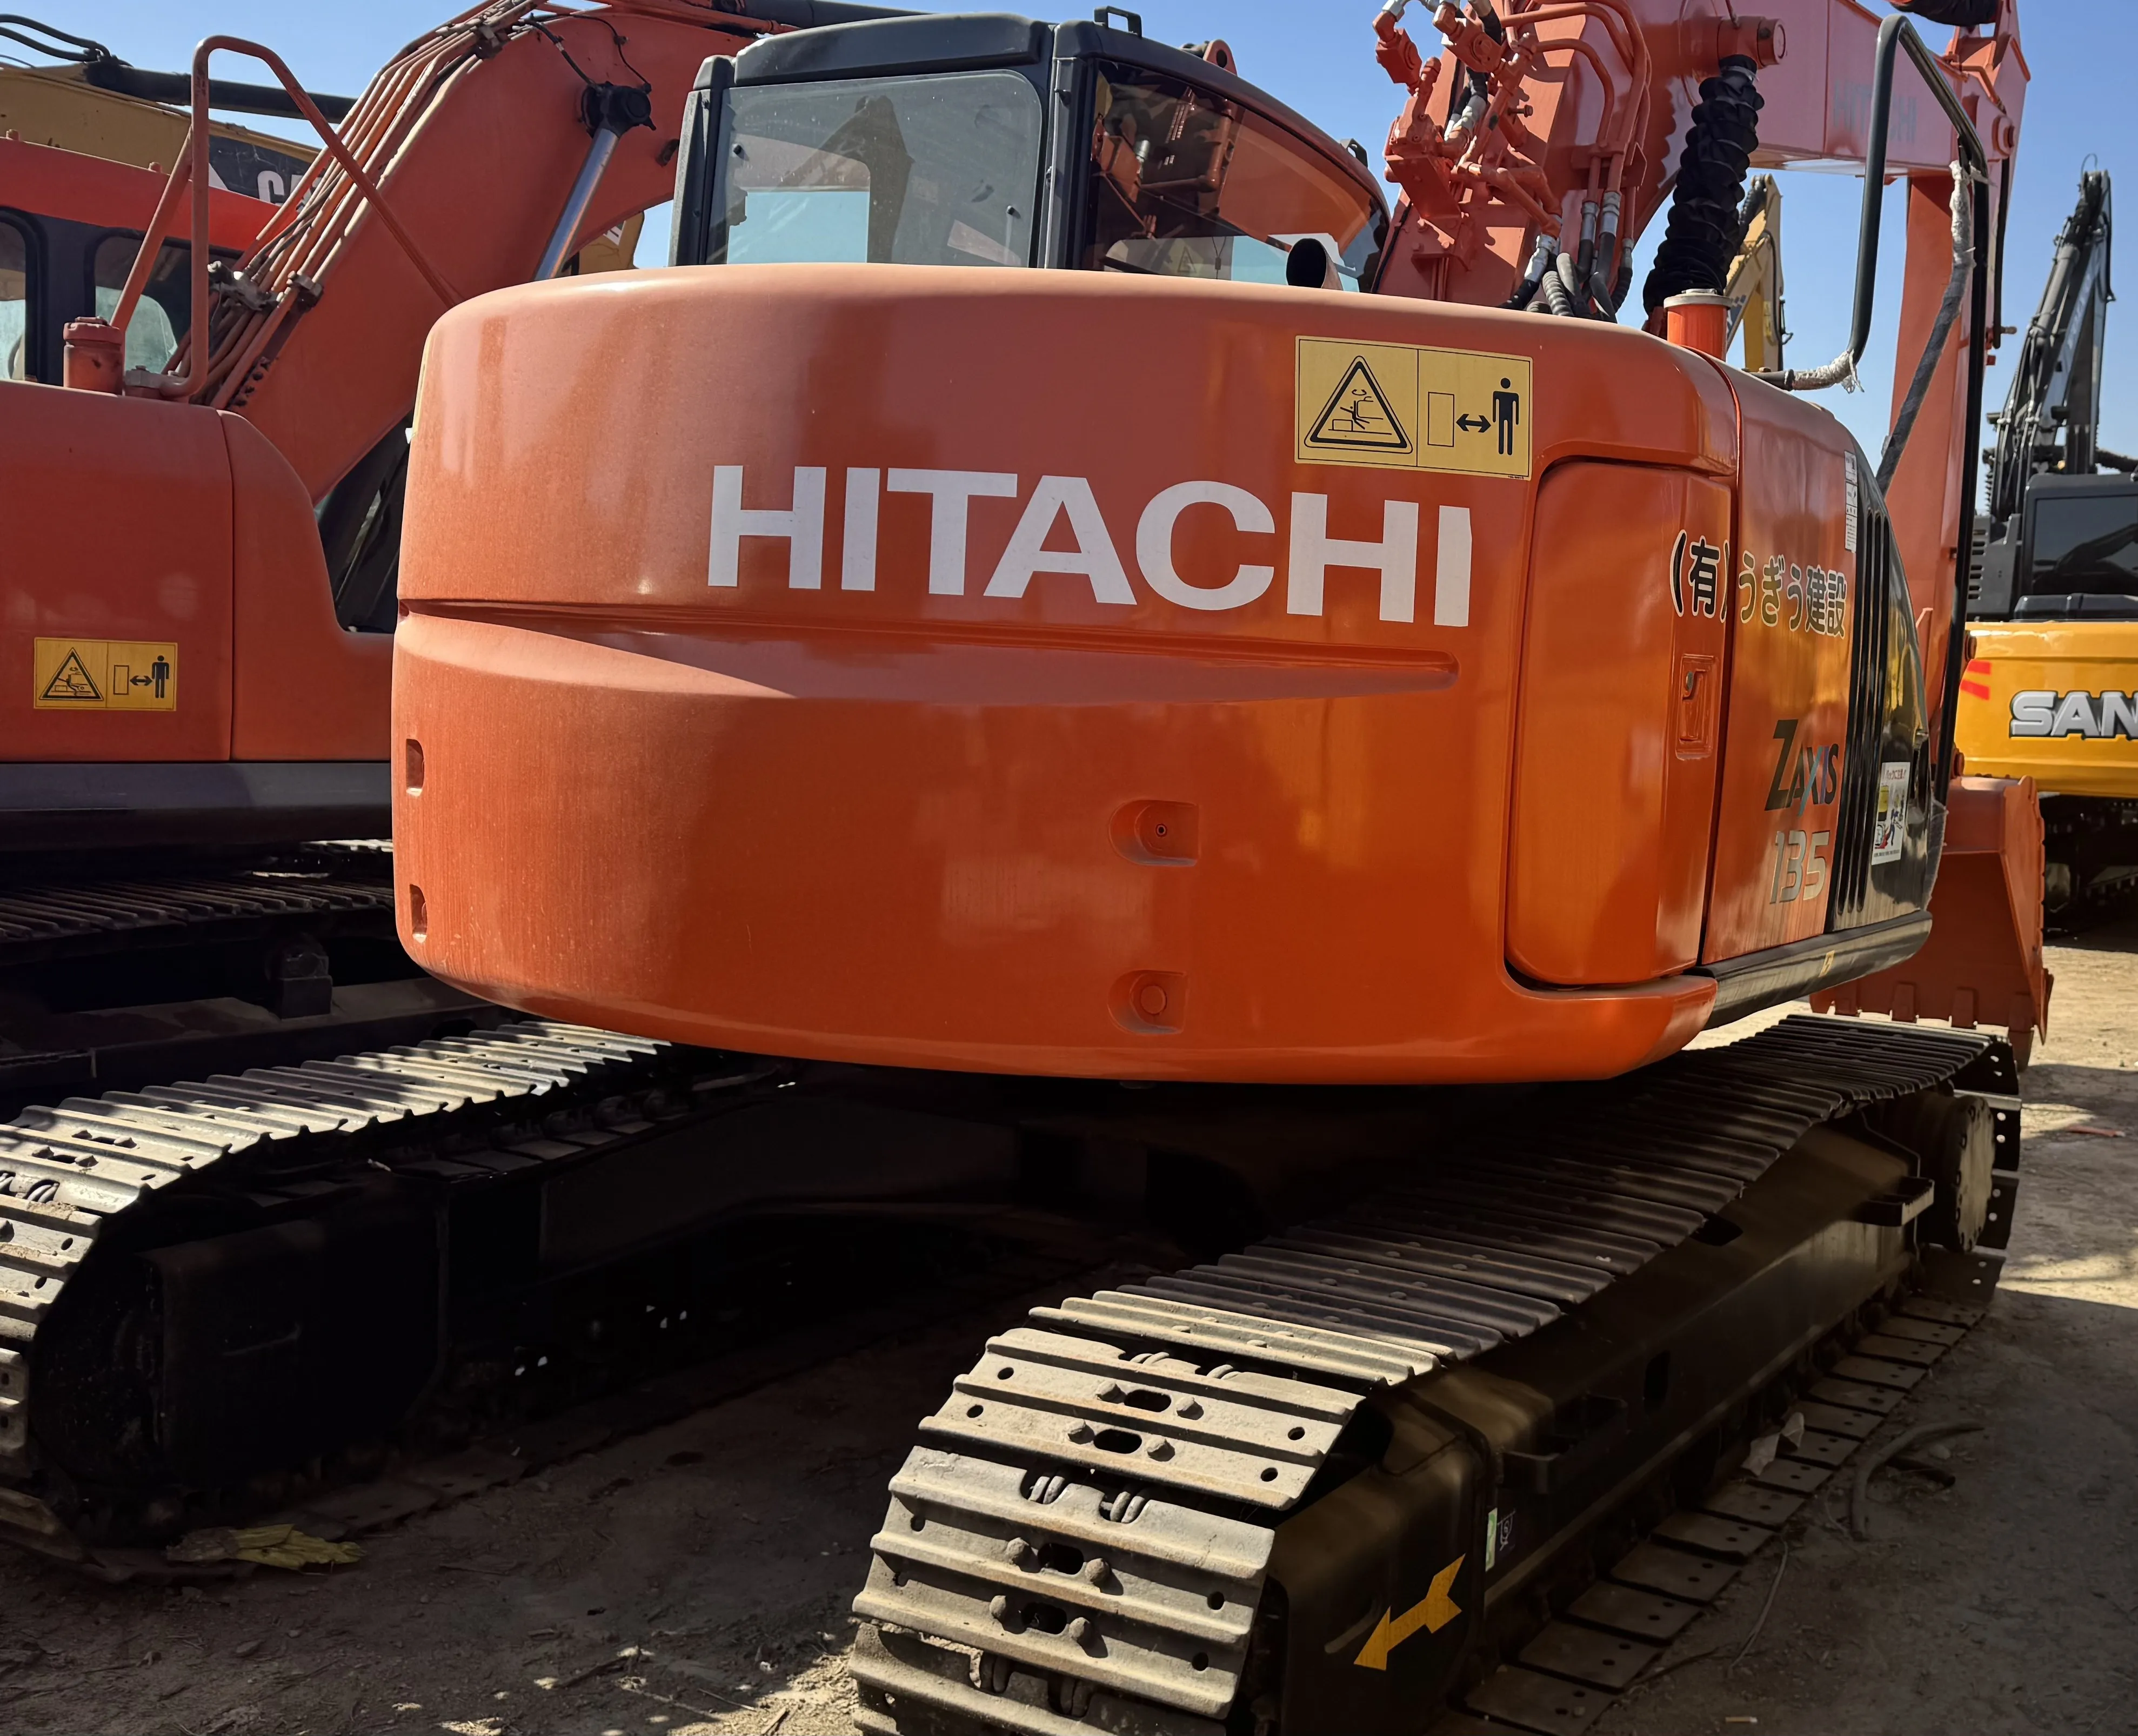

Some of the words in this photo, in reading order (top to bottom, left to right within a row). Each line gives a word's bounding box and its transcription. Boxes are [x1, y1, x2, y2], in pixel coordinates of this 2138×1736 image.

[708, 465, 1472, 627] HITACHI
[1764, 719, 1839, 817] ZAXIS
[1769, 829, 1830, 901] 135
